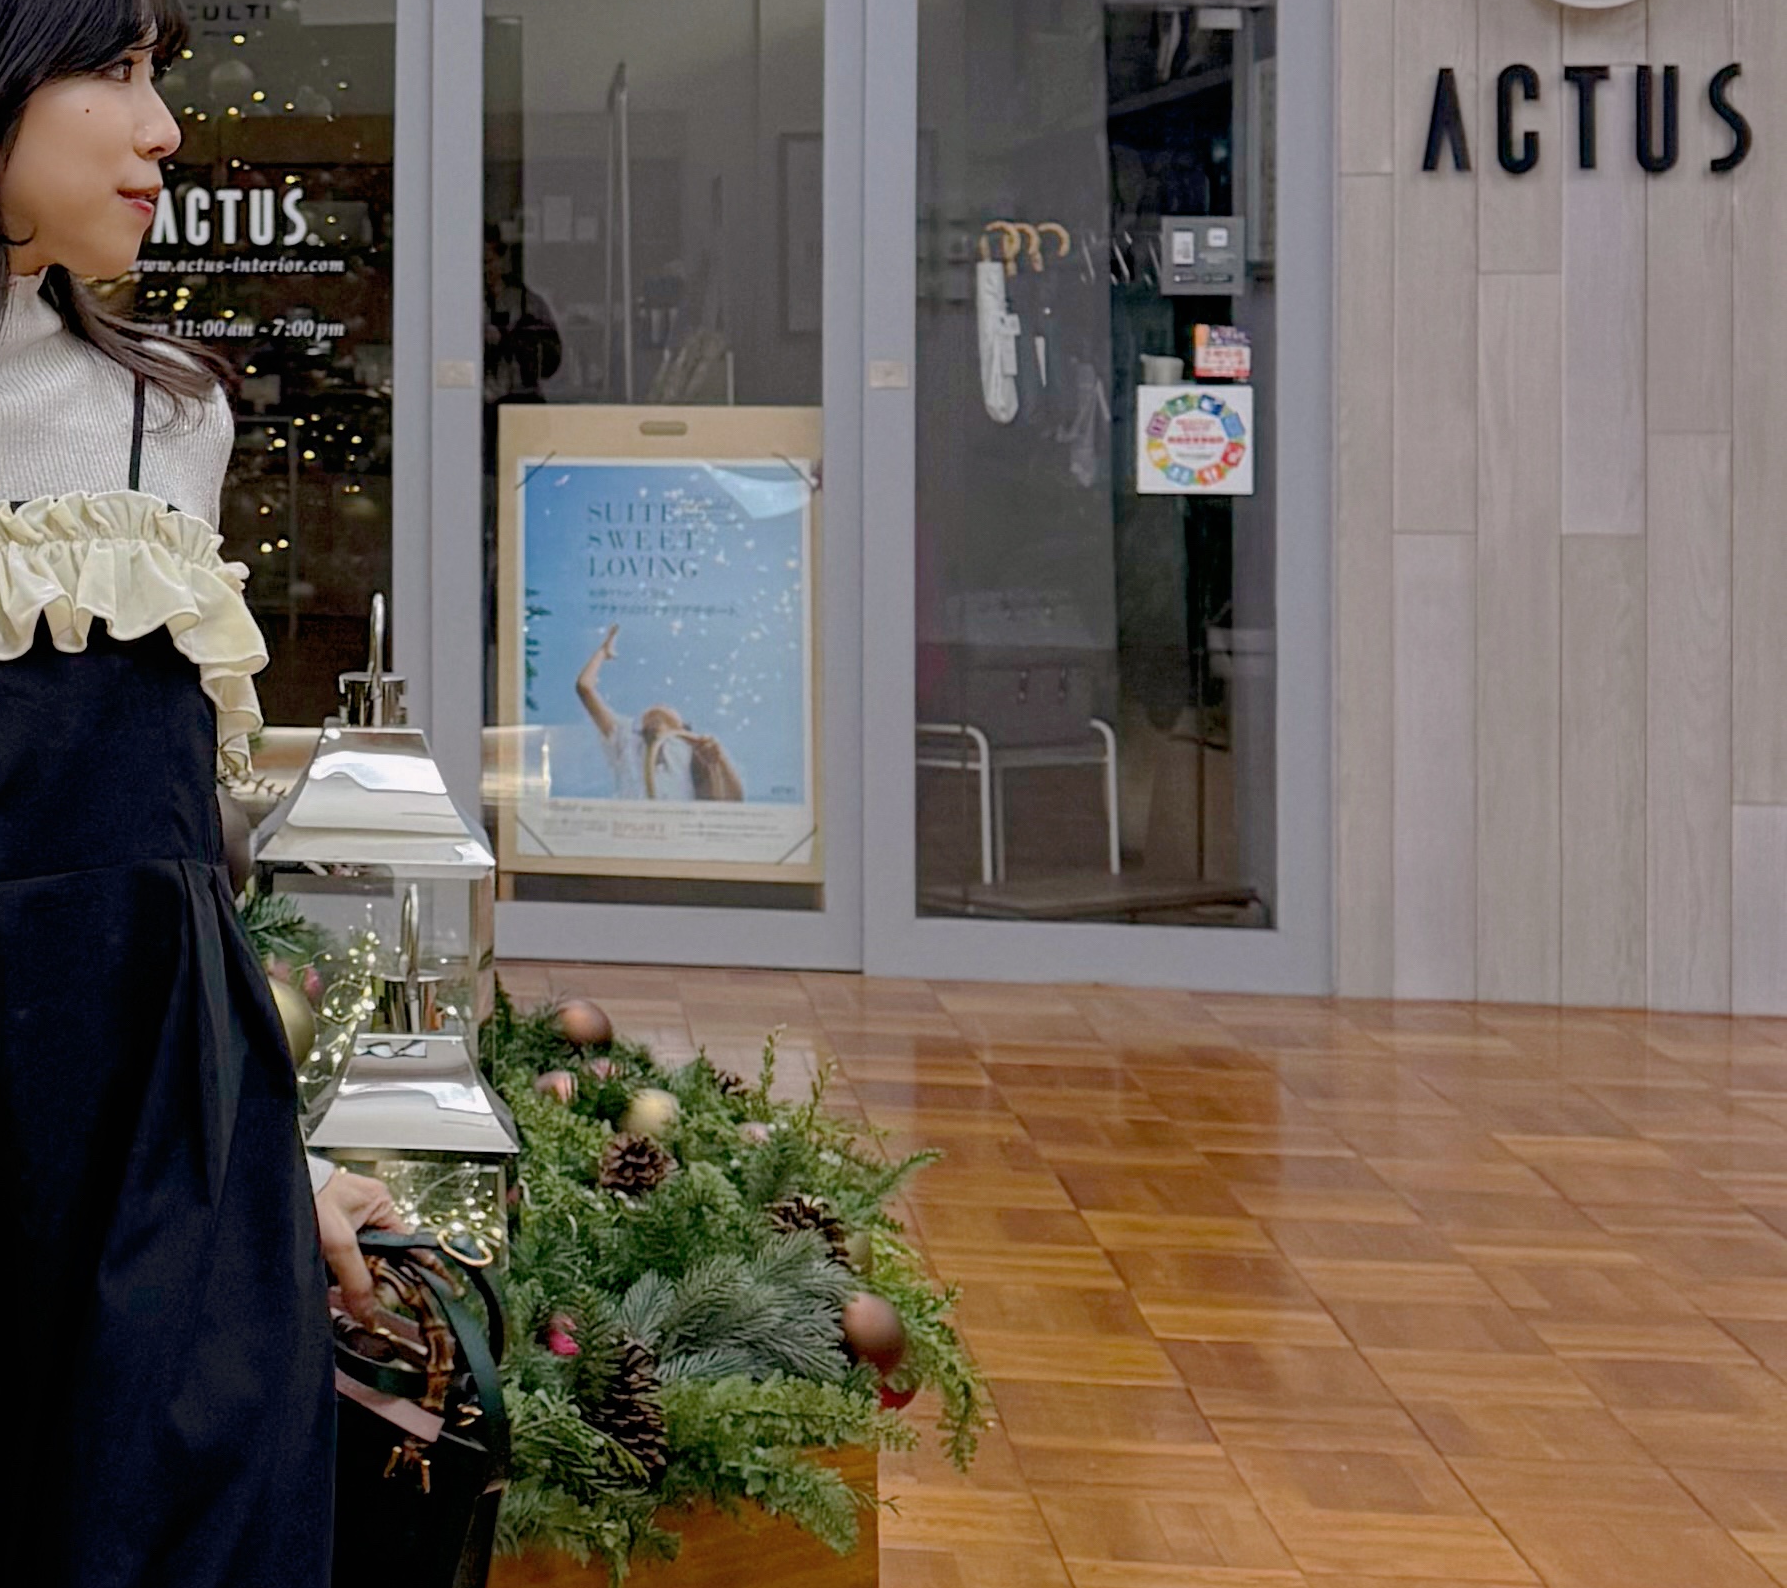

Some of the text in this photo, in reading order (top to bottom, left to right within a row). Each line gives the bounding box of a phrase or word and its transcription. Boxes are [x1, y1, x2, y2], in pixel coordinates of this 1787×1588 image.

[1422, 63, 1753, 174] ACTUS
[150, 187, 308, 246] ACTUS
[587, 530, 696, 551] SWEET
[588, 556, 698, 578] LOVING
